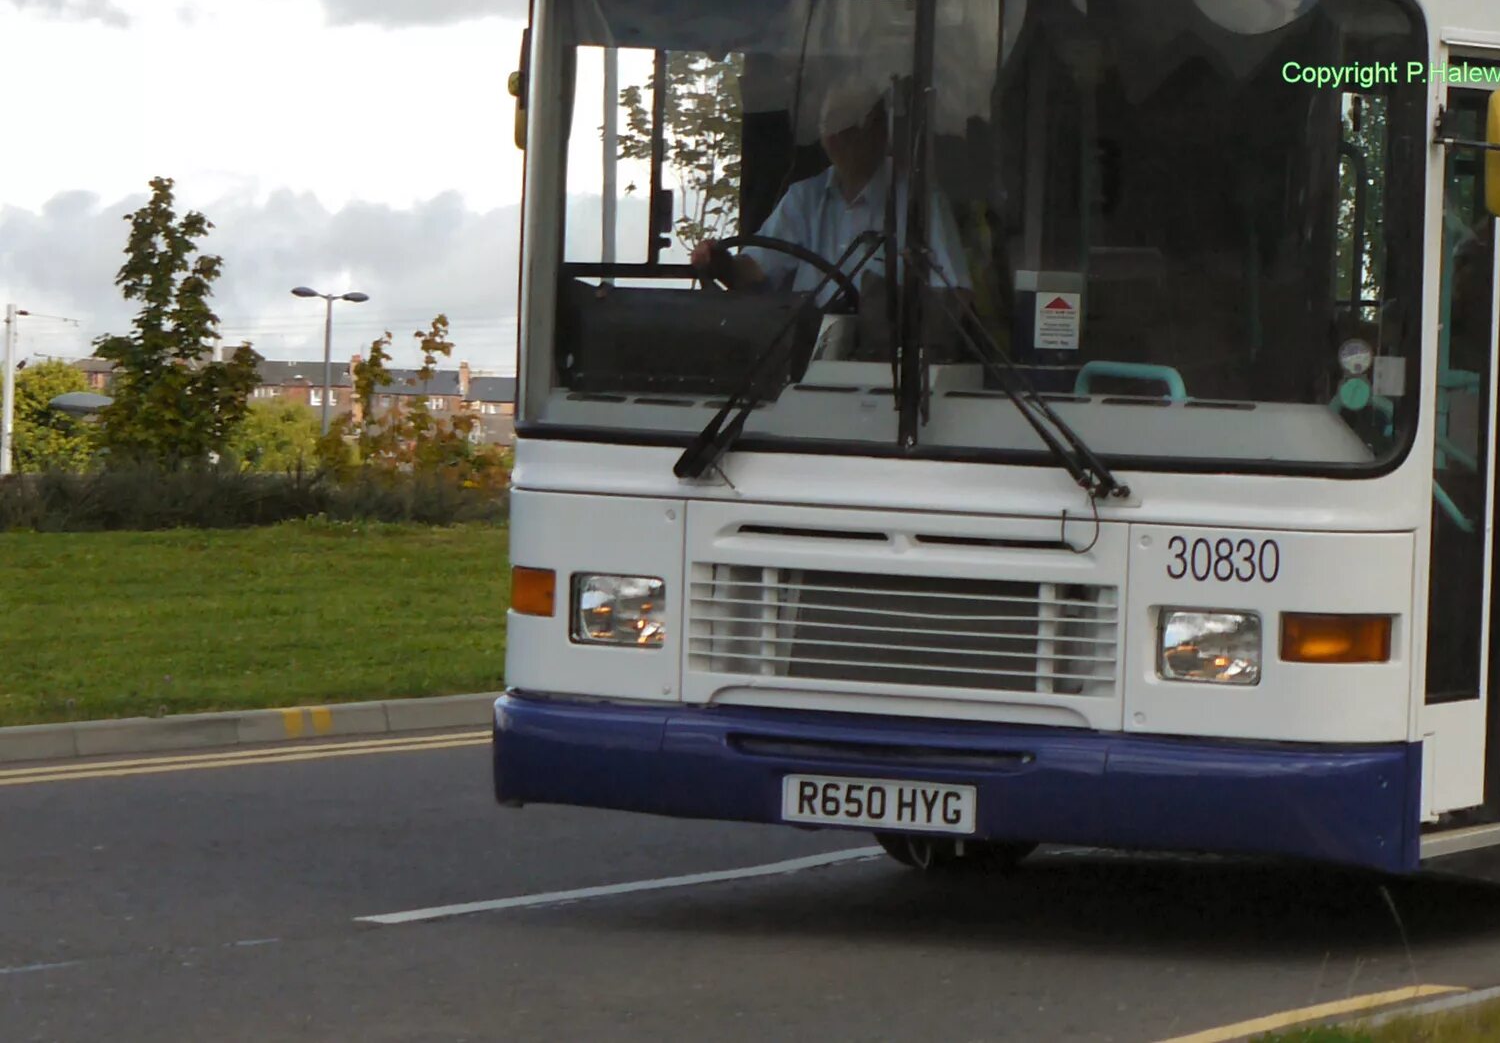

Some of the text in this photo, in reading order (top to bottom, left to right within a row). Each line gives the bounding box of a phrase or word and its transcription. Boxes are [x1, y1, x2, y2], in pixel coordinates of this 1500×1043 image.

[1166, 535, 1280, 583] 30830
[797, 780, 962, 825] R650 HYG
